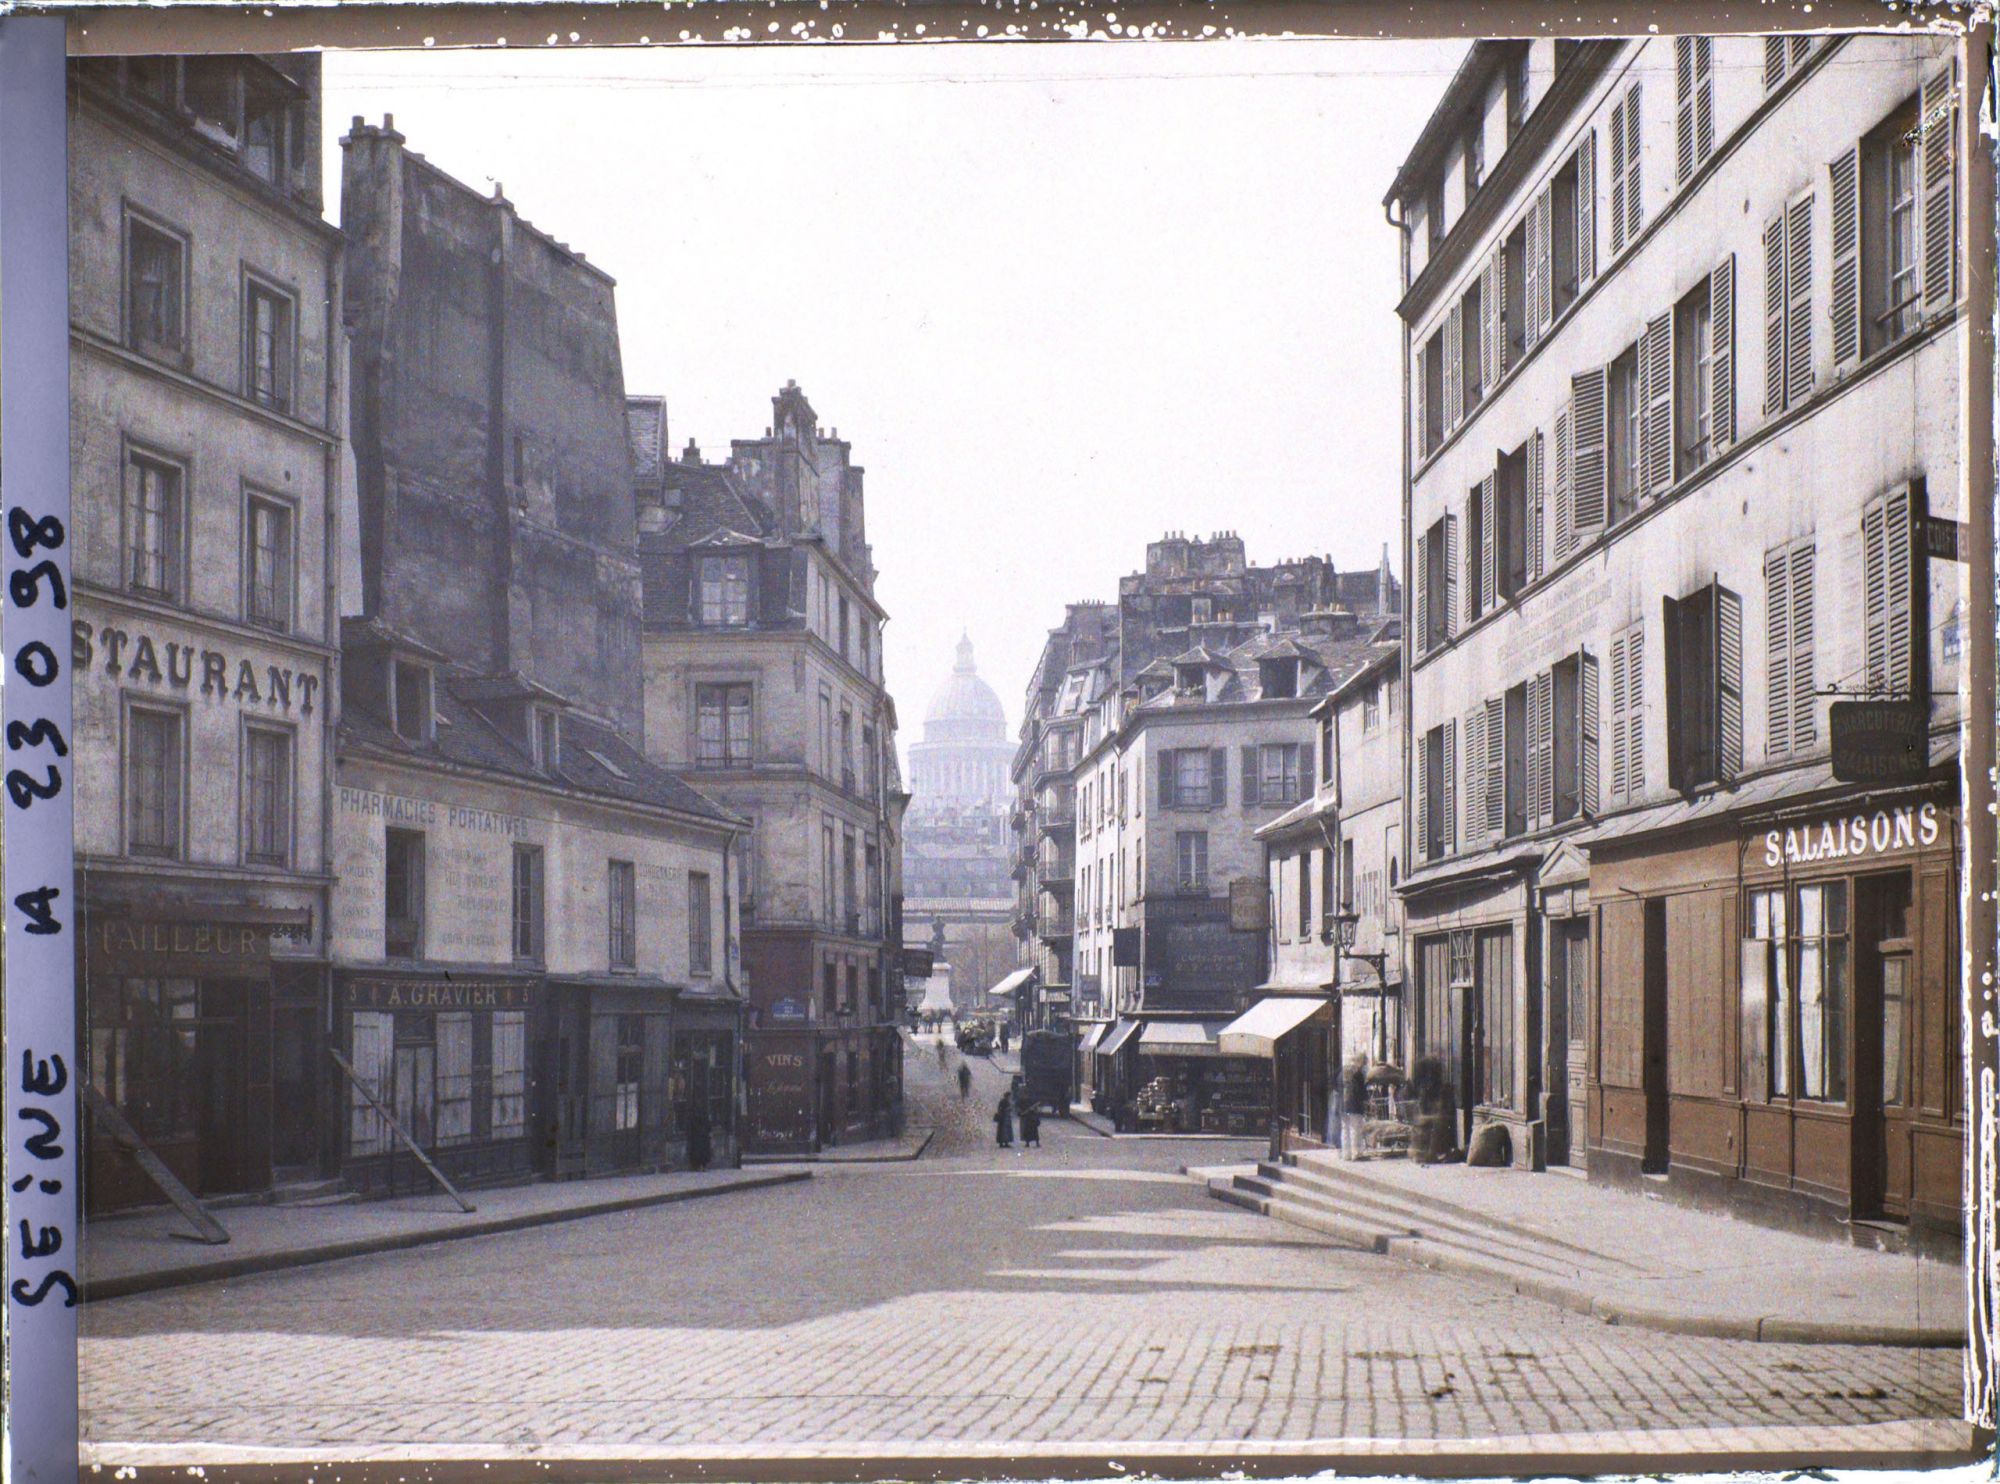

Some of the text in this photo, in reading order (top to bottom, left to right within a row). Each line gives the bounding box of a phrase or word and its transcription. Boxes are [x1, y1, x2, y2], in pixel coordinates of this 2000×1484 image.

[72, 619, 318, 713] STAURANT
[1833, 709, 1922, 737] CHARCUTERIE
[1836, 750, 1921, 775] SALAISONS
[339, 788, 528, 837] PHARMACIES PORTATIVES
[1765, 802, 1939, 868] SALAISONS
[15, 886, 61, 934] A
[97, 920, 257, 954] TAILLEUR
[764, 1053, 804, 1068] VINS
